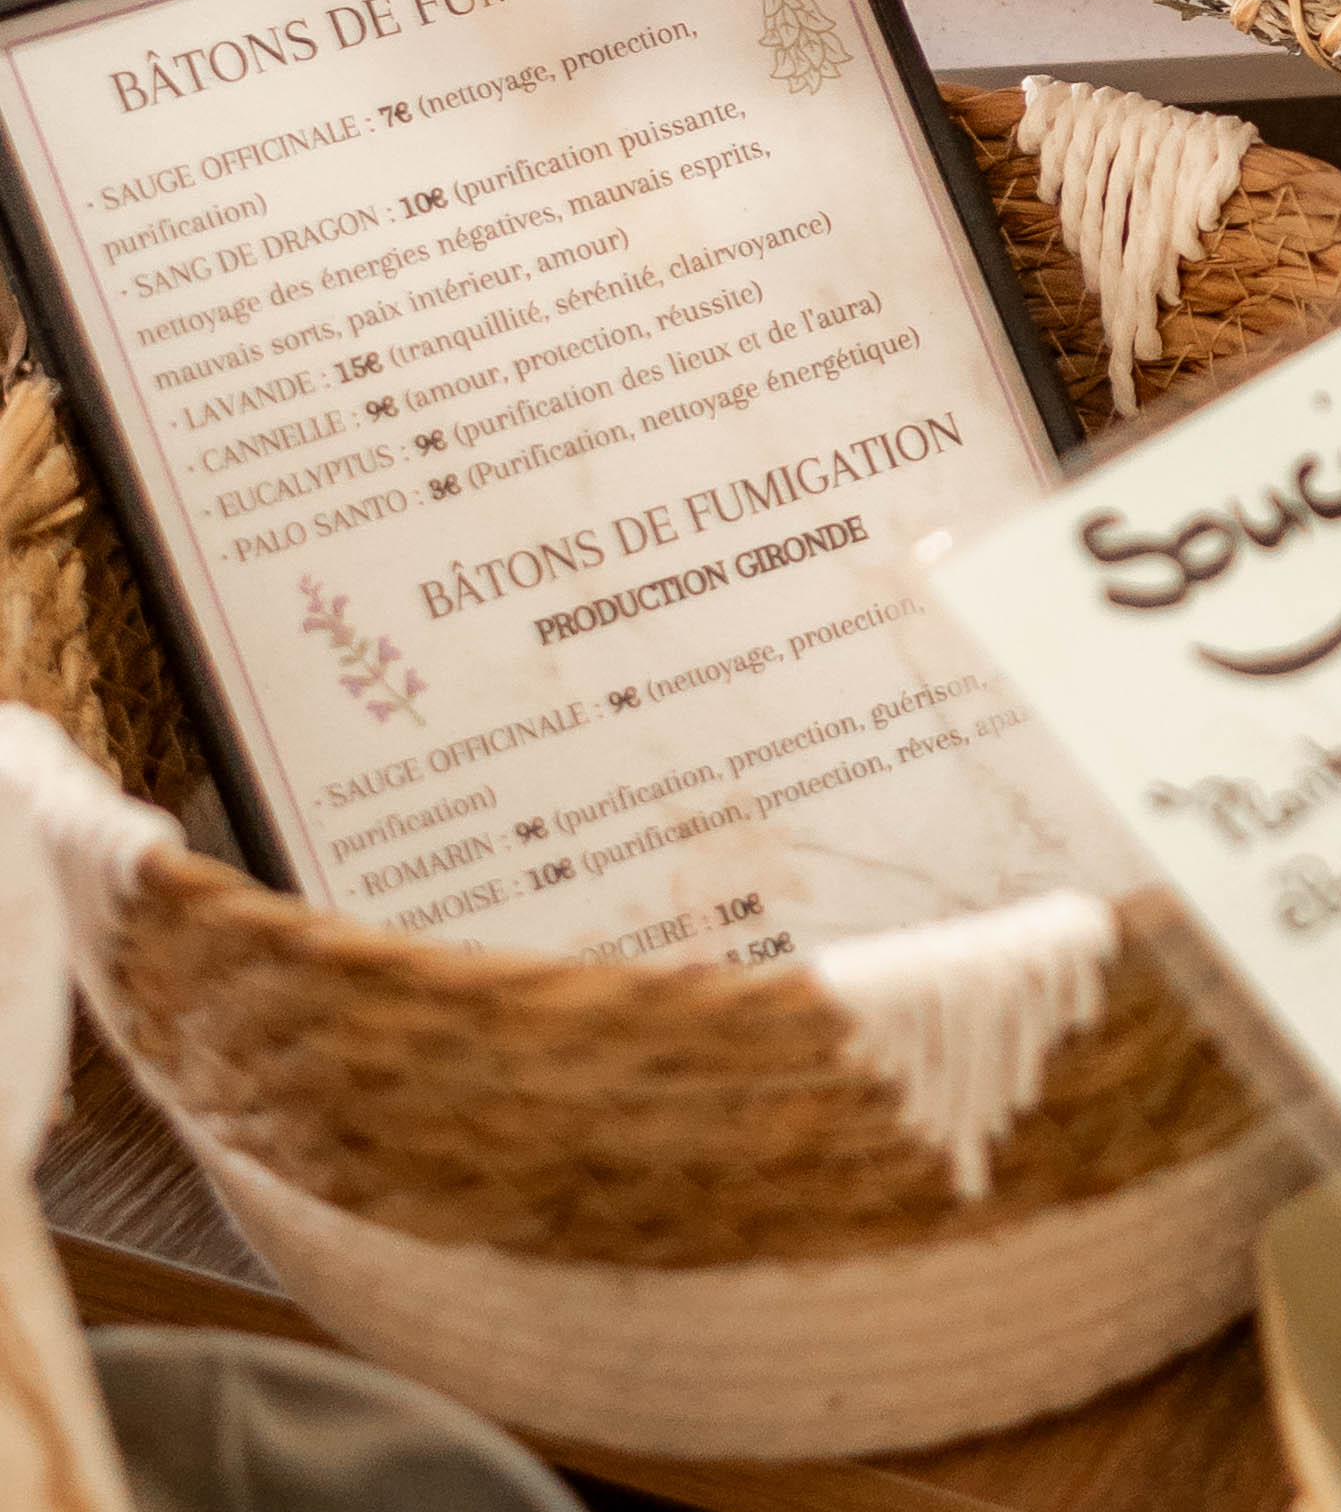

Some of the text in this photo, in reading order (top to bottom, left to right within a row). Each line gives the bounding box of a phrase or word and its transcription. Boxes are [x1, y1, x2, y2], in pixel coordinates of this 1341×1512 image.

[99, 21, 698, 211] SAUGE OFFICINALE 7€ (nettoyage, protection,
[108, 18, 319, 113] BÂTONS
[101, 191, 268, 267] purification)
[132, 101, 747, 299] SANG DE DRAGON 10€ (purification puissante,
[135, 140, 772, 348] nettoyage des énergies négatives, mauvais esprits,
[152, 225, 630, 391] mauvais sorts, paix intérieur, amour)
[182, 209, 833, 431] LAVANDE 15€ (tranquillité, sérénité, clairvoyance)
[200, 279, 764, 474] CANNELLE 9€ (amour, protection, réussite)
[215, 289, 883, 520] EUCALYPTUS 9€ (purification des lieux et de l'aura)
[232, 521, 308, 563] PALO
[312, 488, 409, 538] SANTO
[466, 423, 636, 491] (Purification,
[639, 381, 760, 434] nettoyage
[764, 324, 921, 393] énergétique)
[418, 410, 964, 620] BÂTONS DE FUMIGATION
[532, 514, 870, 647] PRODUCTION GIRONDE
[324, 757, 424, 808] SAUGE
[427, 700, 591, 774] OFFICINALE
[603, 684, 643, 716] 9€
[645, 644, 785, 704] (nettoyage,
[360, 832, 495, 898] ROMARIN
[510, 815, 551, 847] 9€
[551, 764, 724, 836] (purification,
[724, 715, 867, 781] protection,
[525, 854, 577, 891] 10€
[577, 793, 754, 876] (purification,
[754, 756, 893, 819] protection,
[895, 728, 970, 764] rêves,
[329, 783, 498, 865] purification)
[714, 892, 764, 926] 10€
